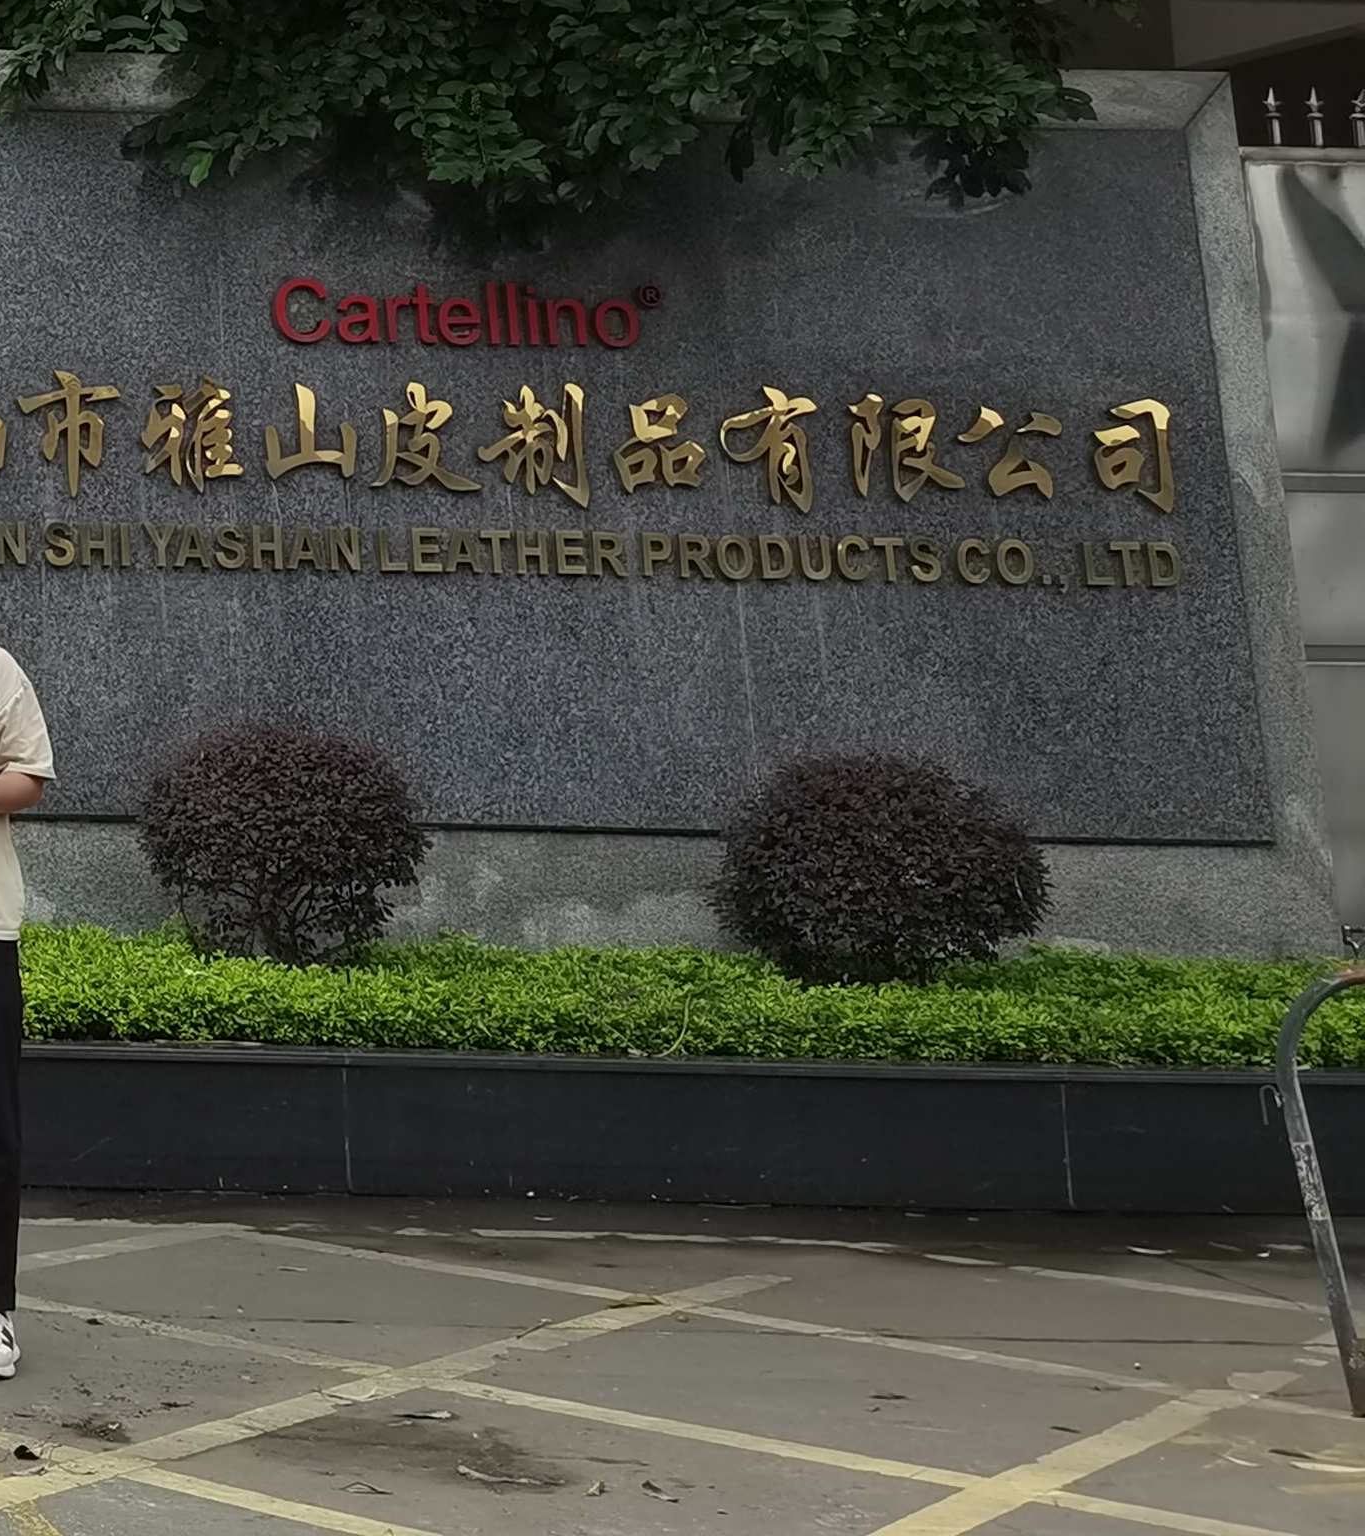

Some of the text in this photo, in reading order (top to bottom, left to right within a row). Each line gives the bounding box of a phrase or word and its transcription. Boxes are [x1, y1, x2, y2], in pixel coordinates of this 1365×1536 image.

[273, 278, 639, 348] Cartellino
[43, 520, 131, 568] SHI
[141, 523, 362, 572] YASHAN
[377, 527, 629, 577] LEATHER
[640, 532, 943, 584] PRODUCTS
